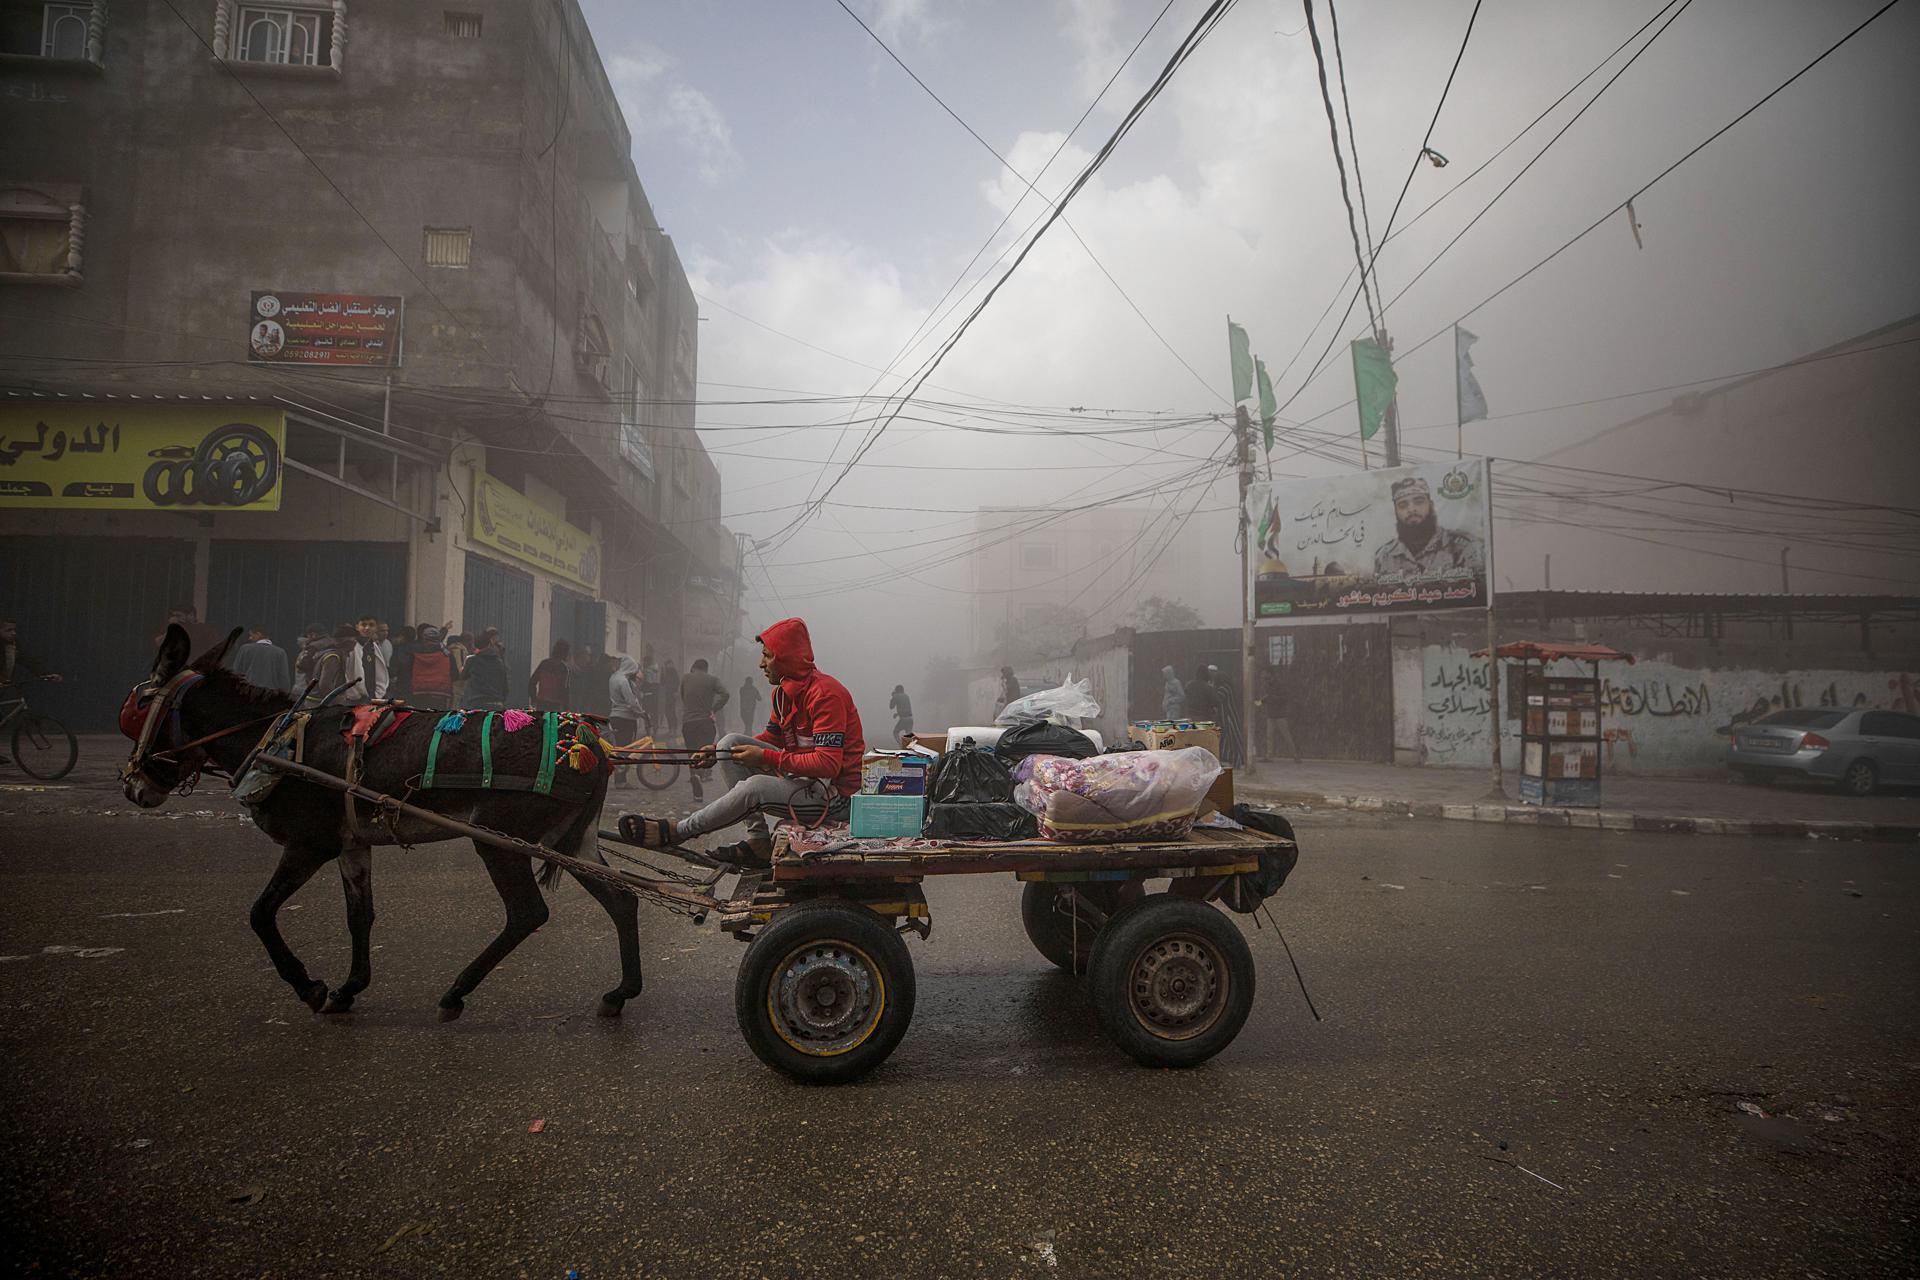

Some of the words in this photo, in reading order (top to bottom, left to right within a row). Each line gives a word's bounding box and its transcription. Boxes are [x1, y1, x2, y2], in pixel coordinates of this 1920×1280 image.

[282, 301, 317, 316] التعليمي
[343, 302, 371, 316] مستقبل
[373, 304, 395, 318] مركز
[0, 419, 120, 466] الدولي
[0, 483, 32, 496] جمل
[1294, 501, 1324, 528] عليك
[1296, 526, 1355, 551] الخالدين
[1354, 520, 1365, 547] في
[1372, 587, 1417, 606] الكريم
